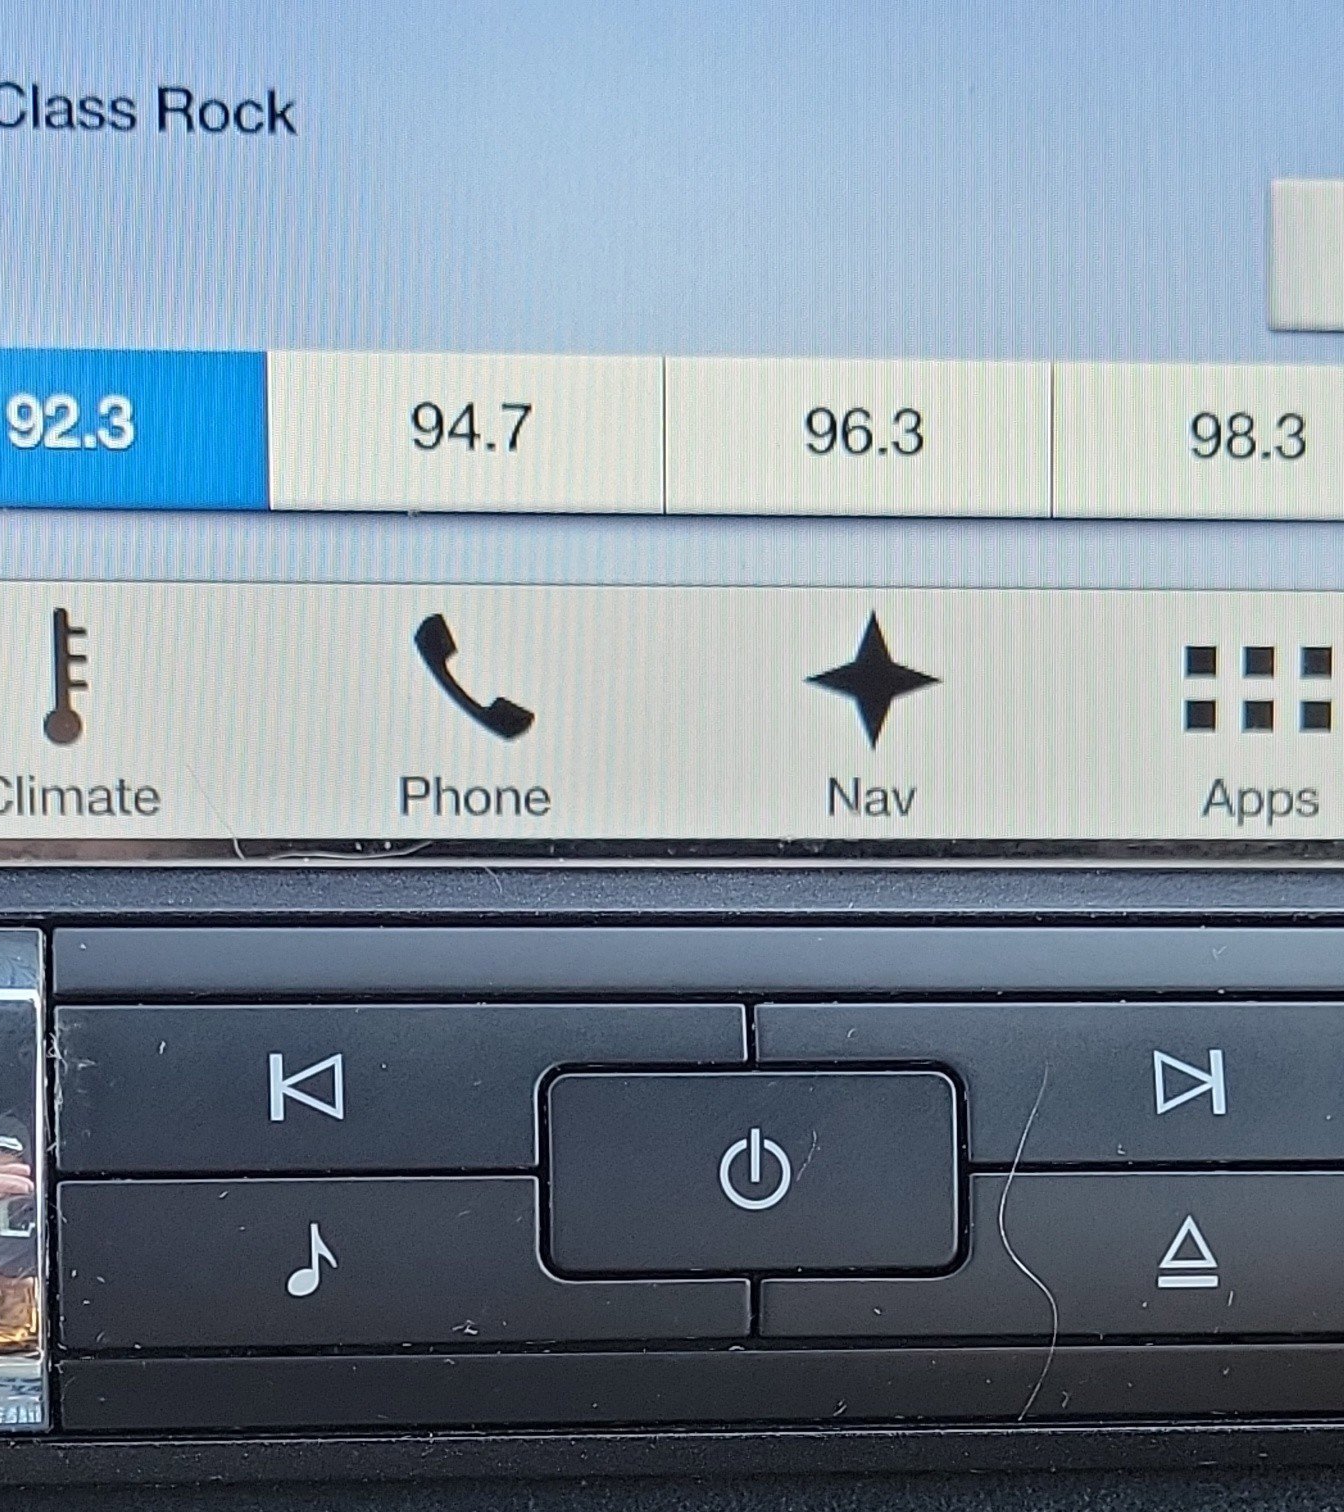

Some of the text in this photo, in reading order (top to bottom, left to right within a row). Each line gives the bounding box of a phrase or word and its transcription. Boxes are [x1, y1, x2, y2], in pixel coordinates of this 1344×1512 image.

[157, 86, 297, 136] Rock
[6, 394, 134, 451] 92.3
[410, 401, 533, 454] 94.7
[803, 406, 924, 457] 96.3
[1189, 411, 1308, 461] 98.3
[400, 775, 551, 818] Phone
[827, 777, 917, 818] Nav
[1202, 778, 1320, 830] Apps
